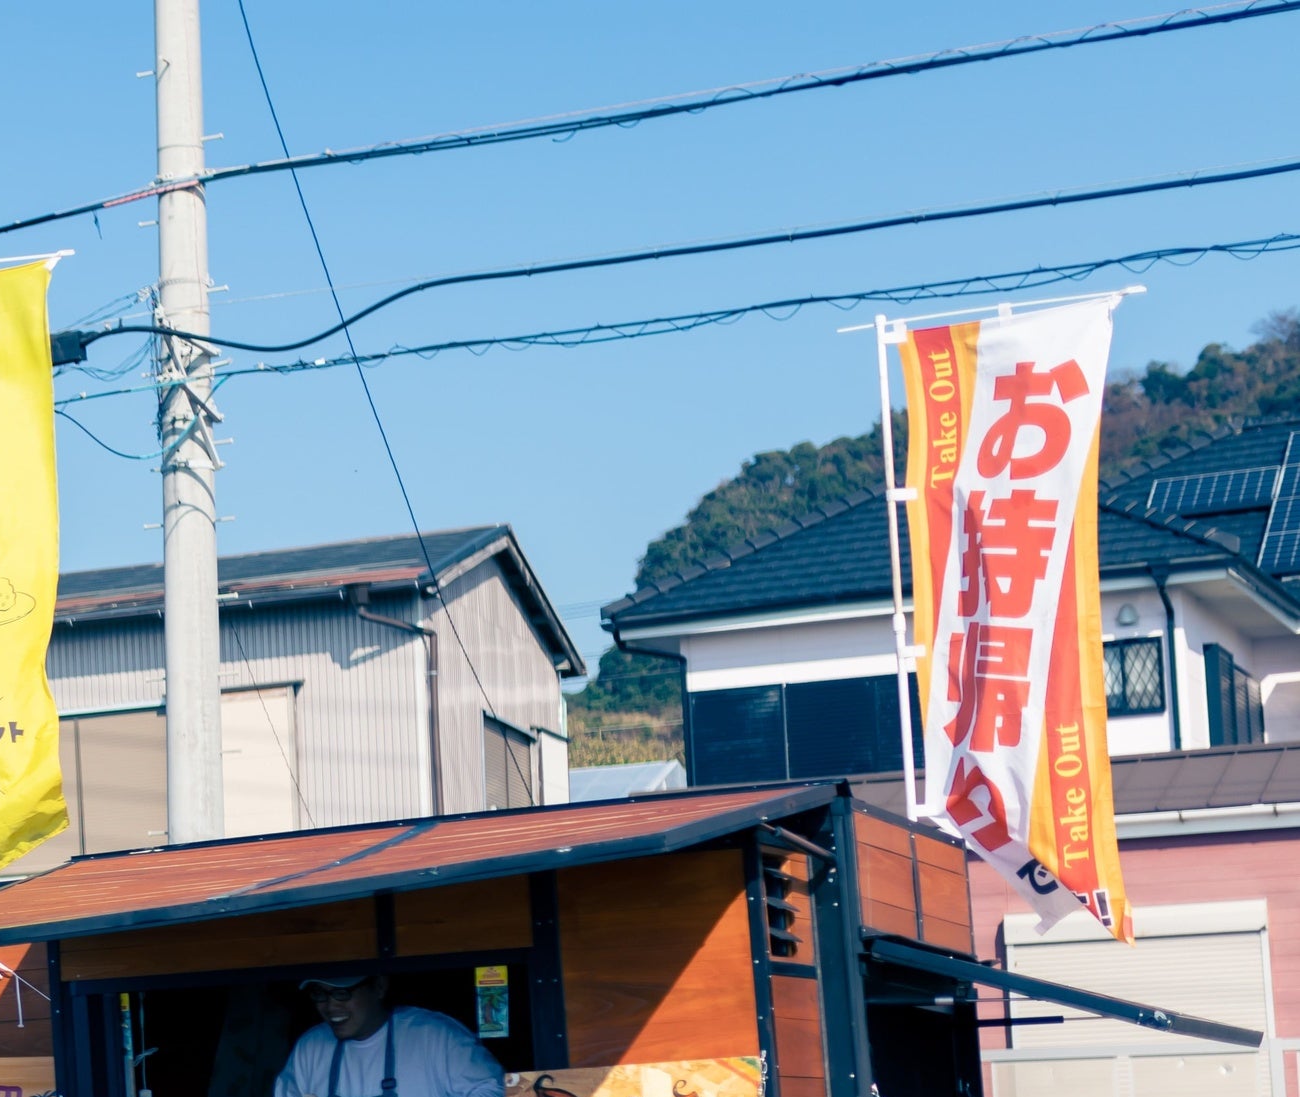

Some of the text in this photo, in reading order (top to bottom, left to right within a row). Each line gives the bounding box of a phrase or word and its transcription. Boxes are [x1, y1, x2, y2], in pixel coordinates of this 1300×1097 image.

[929, 348, 957, 489] Take Out
[944, 360, 1091, 853] お持帰り
[1055, 721, 1090, 869] Take Out
